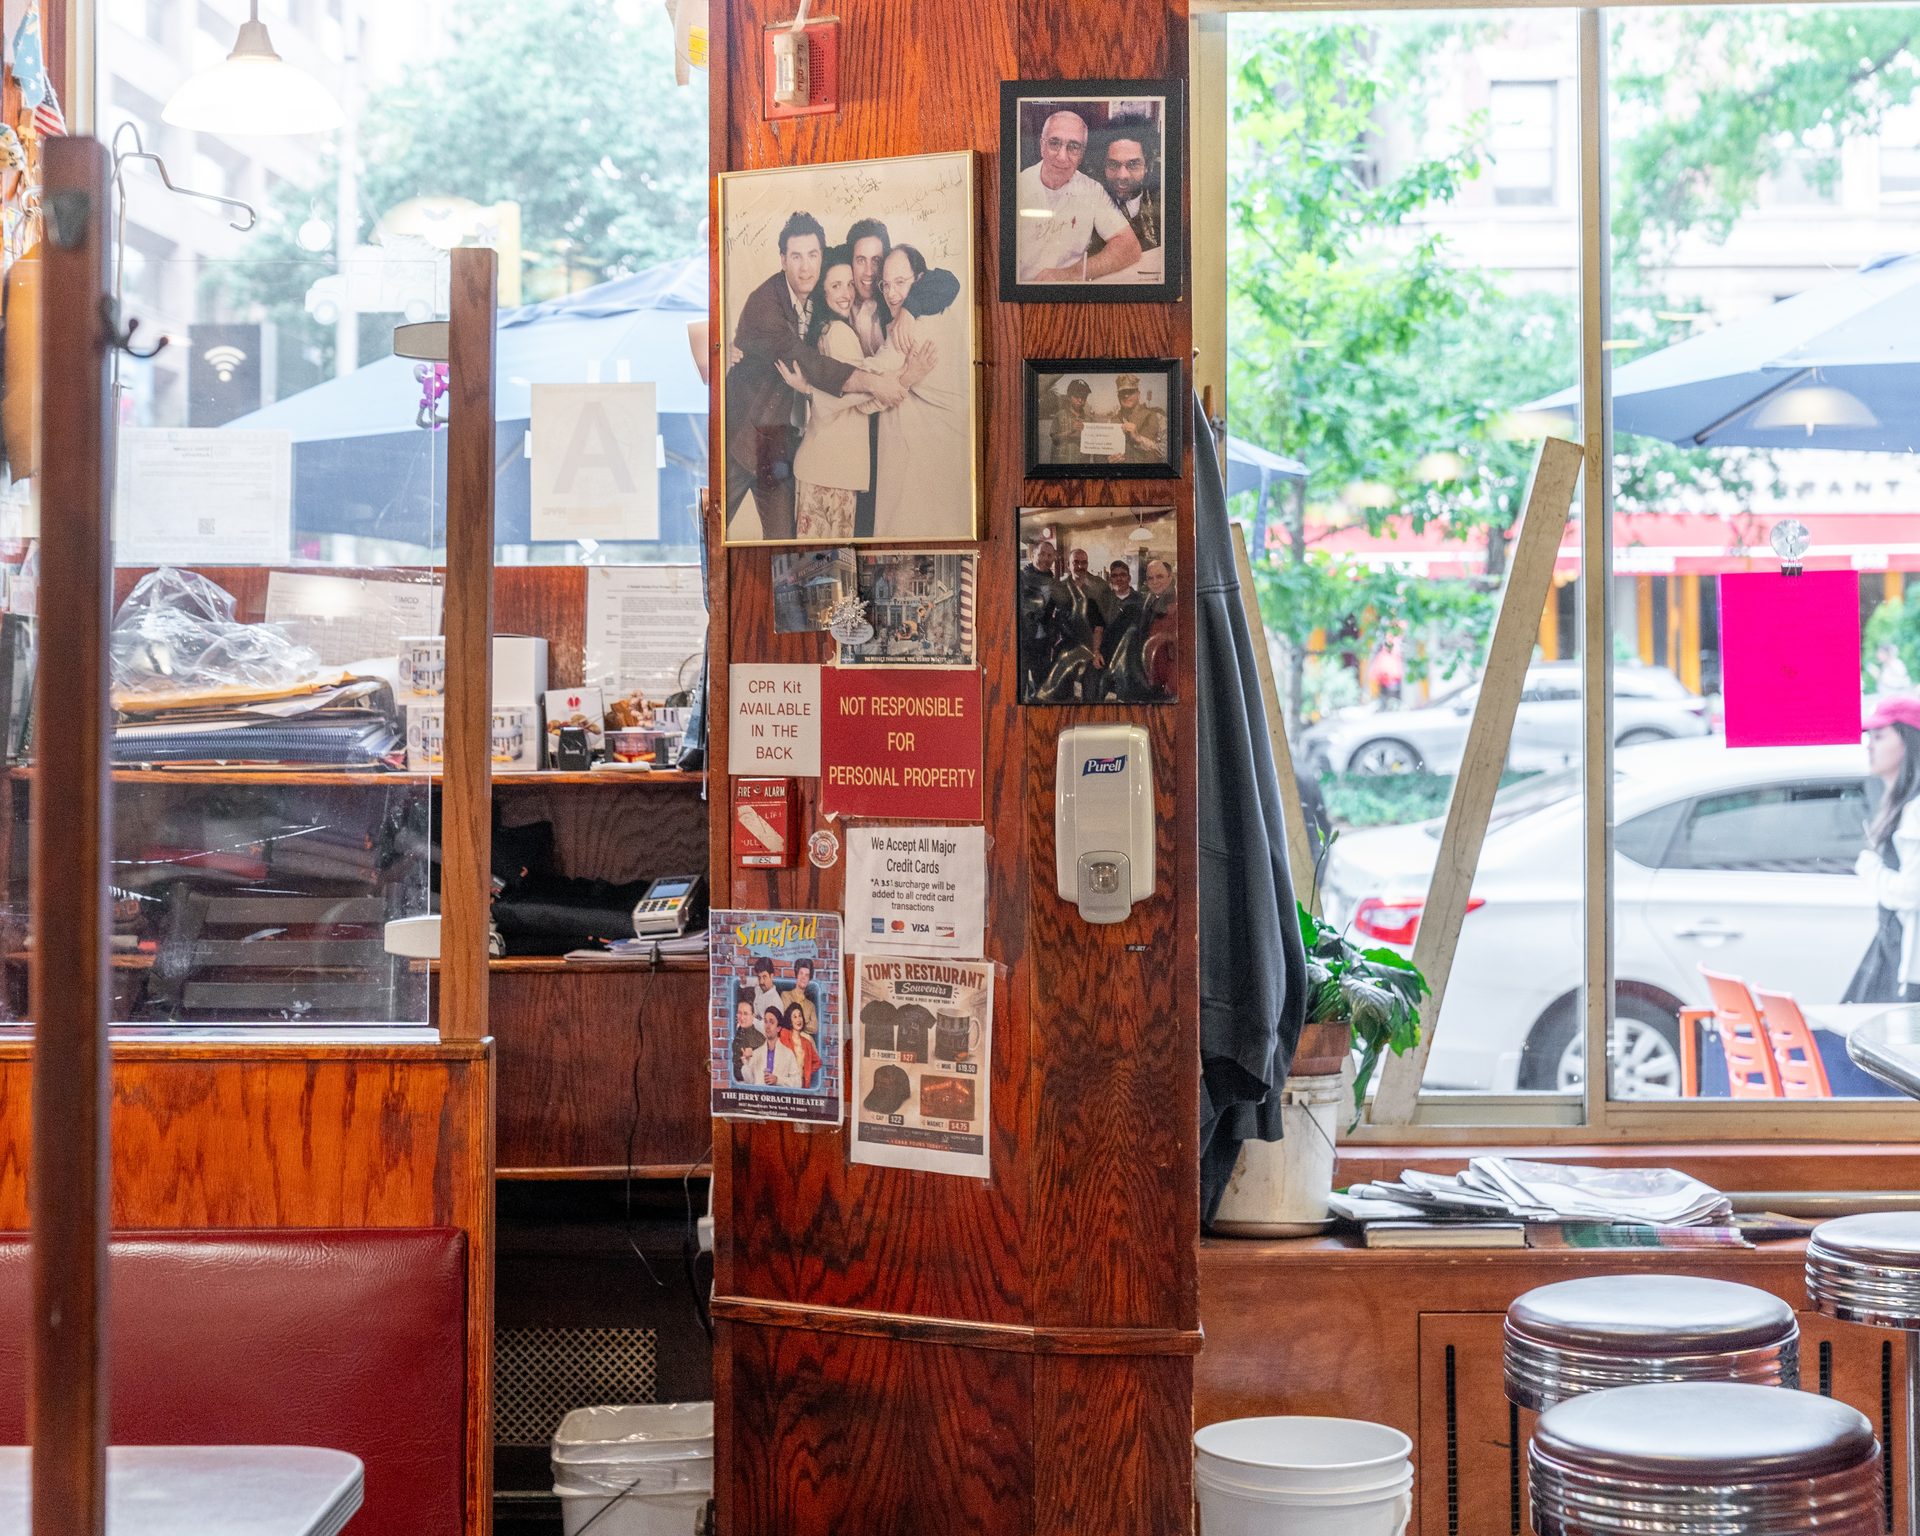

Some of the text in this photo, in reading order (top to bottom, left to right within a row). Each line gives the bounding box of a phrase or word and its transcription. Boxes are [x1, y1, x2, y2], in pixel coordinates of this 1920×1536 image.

[748, 680, 802, 694] CPR Kit
[740, 702, 811, 716] AVAILABLE
[840, 696, 964, 717] NOT RESPONSIBLE
[752, 724, 798, 738] IN THE
[888, 732, 915, 752] FOR
[756, 746, 793, 760] BACK
[1087, 760, 1122, 772] Purell
[829, 766, 976, 788] PERSONAL PROPERTY
[738, 786, 785, 798] FIRE ALARM
[871, 836, 956, 856] We Accept All Major
[886, 858, 940, 874] Credit Cards
[894, 880, 930, 891] surcharge
[932, 881, 944, 890] will
[946, 882, 956, 890] be
[872, 890, 895, 899] added
[896, 891, 904, 899] to
[915, 892, 936, 901] credit
[937, 893, 954, 902] card
[891, 902, 934, 912] transactions
[735, 916, 818, 948] Singfeld
[911, 924, 930, 932] VISA
[865, 963, 985, 990] TOM'S RESTAURANT
[901, 982, 947, 996] Souvenirs
[958, 1064, 976, 1073] $19.50
[738, 1092, 760, 1101] JERRY
[761, 1094, 792, 1104] ORBACH
[792, 1098, 825, 1106] THEATER
[890, 1116, 902, 1124] $22
[950, 1123, 968, 1131] $4.75
